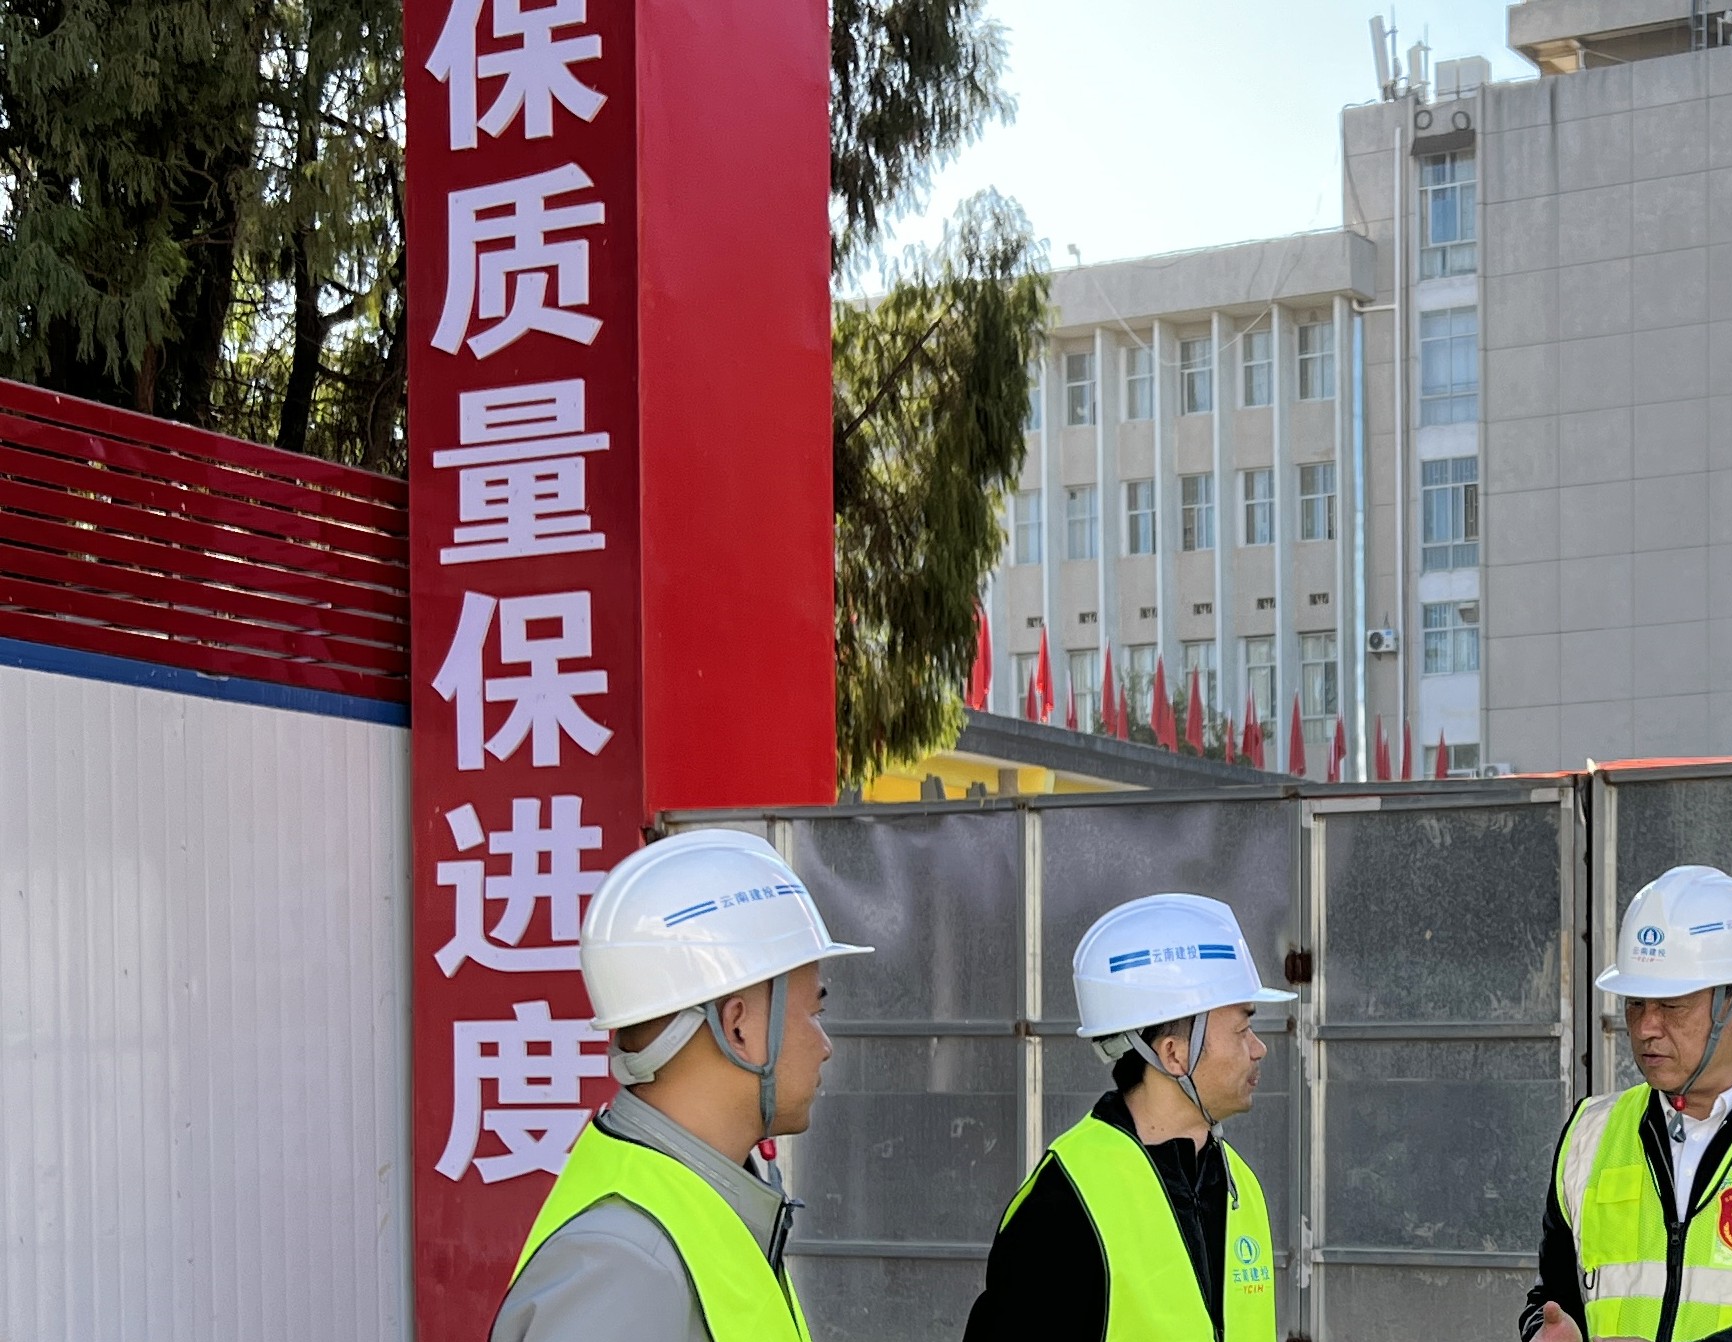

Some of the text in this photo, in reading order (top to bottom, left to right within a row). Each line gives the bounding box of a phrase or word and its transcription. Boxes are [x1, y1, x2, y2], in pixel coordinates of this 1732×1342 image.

[425, 0, 614, 1184] 保质量保进度
[719, 885, 776, 908] 云南建投
[1151, 945, 1198, 963] 云南建投
[1232, 1265, 1270, 1283] 云南建投
